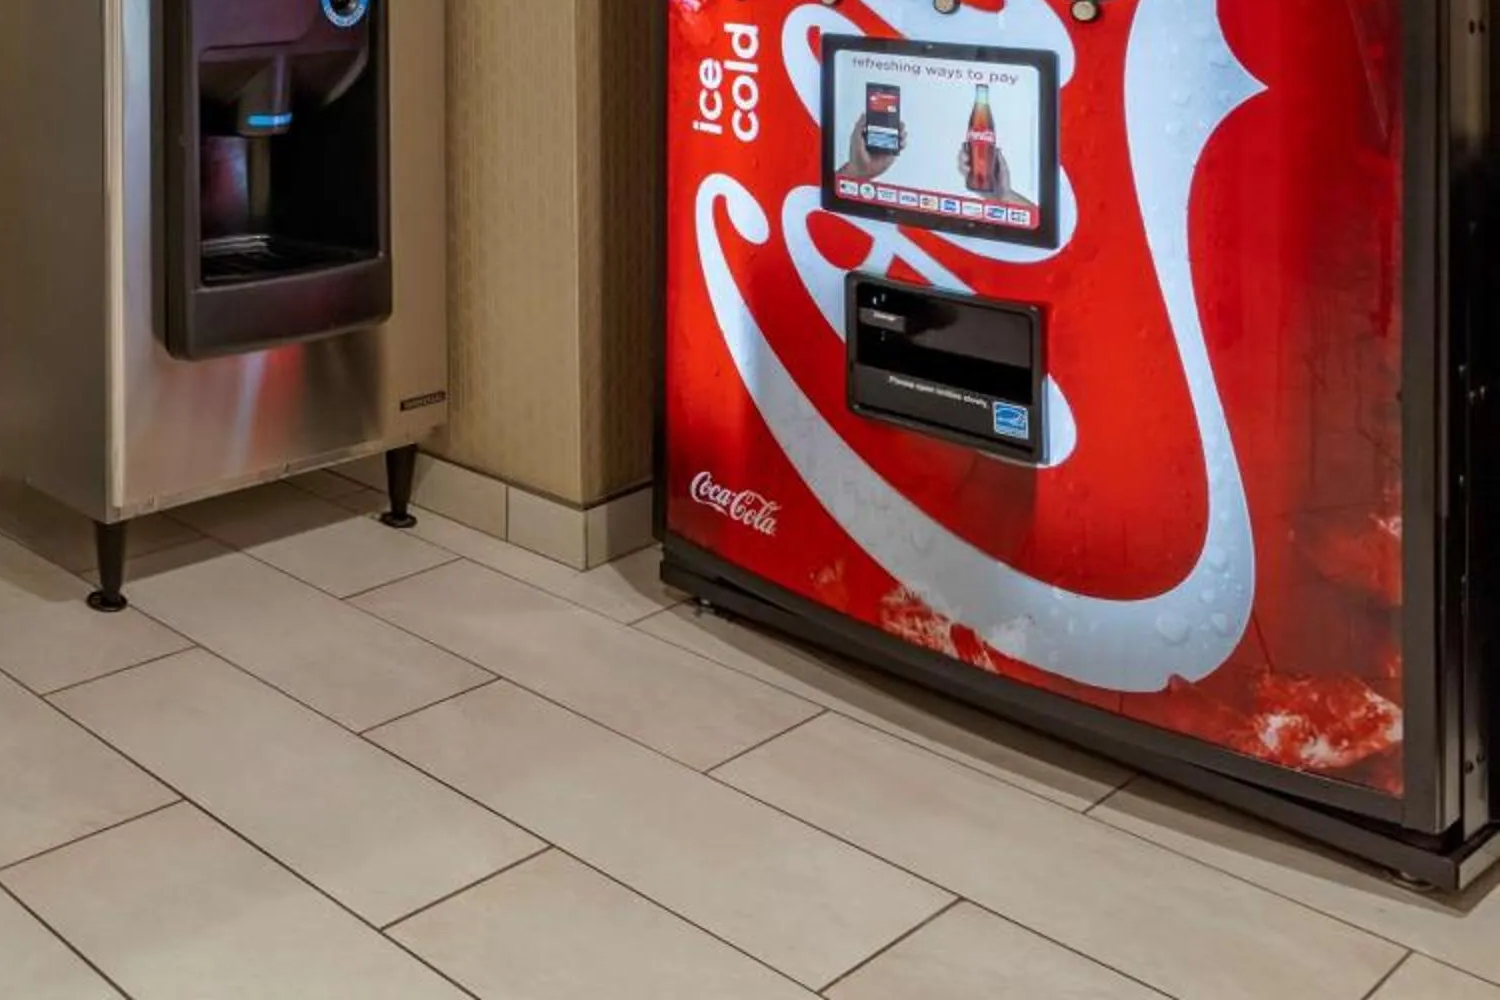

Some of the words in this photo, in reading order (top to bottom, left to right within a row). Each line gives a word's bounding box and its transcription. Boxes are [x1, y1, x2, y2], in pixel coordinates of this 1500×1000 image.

[692, 57, 723, 135] ice
[723, 22, 759, 142] cold
[852, 56, 922, 76] refreshing
[926, 66, 963, 80] ways
[968, 69, 984, 81] to
[989, 71, 1019, 85] pay
[691, 471, 782, 537] Coca-Cola
